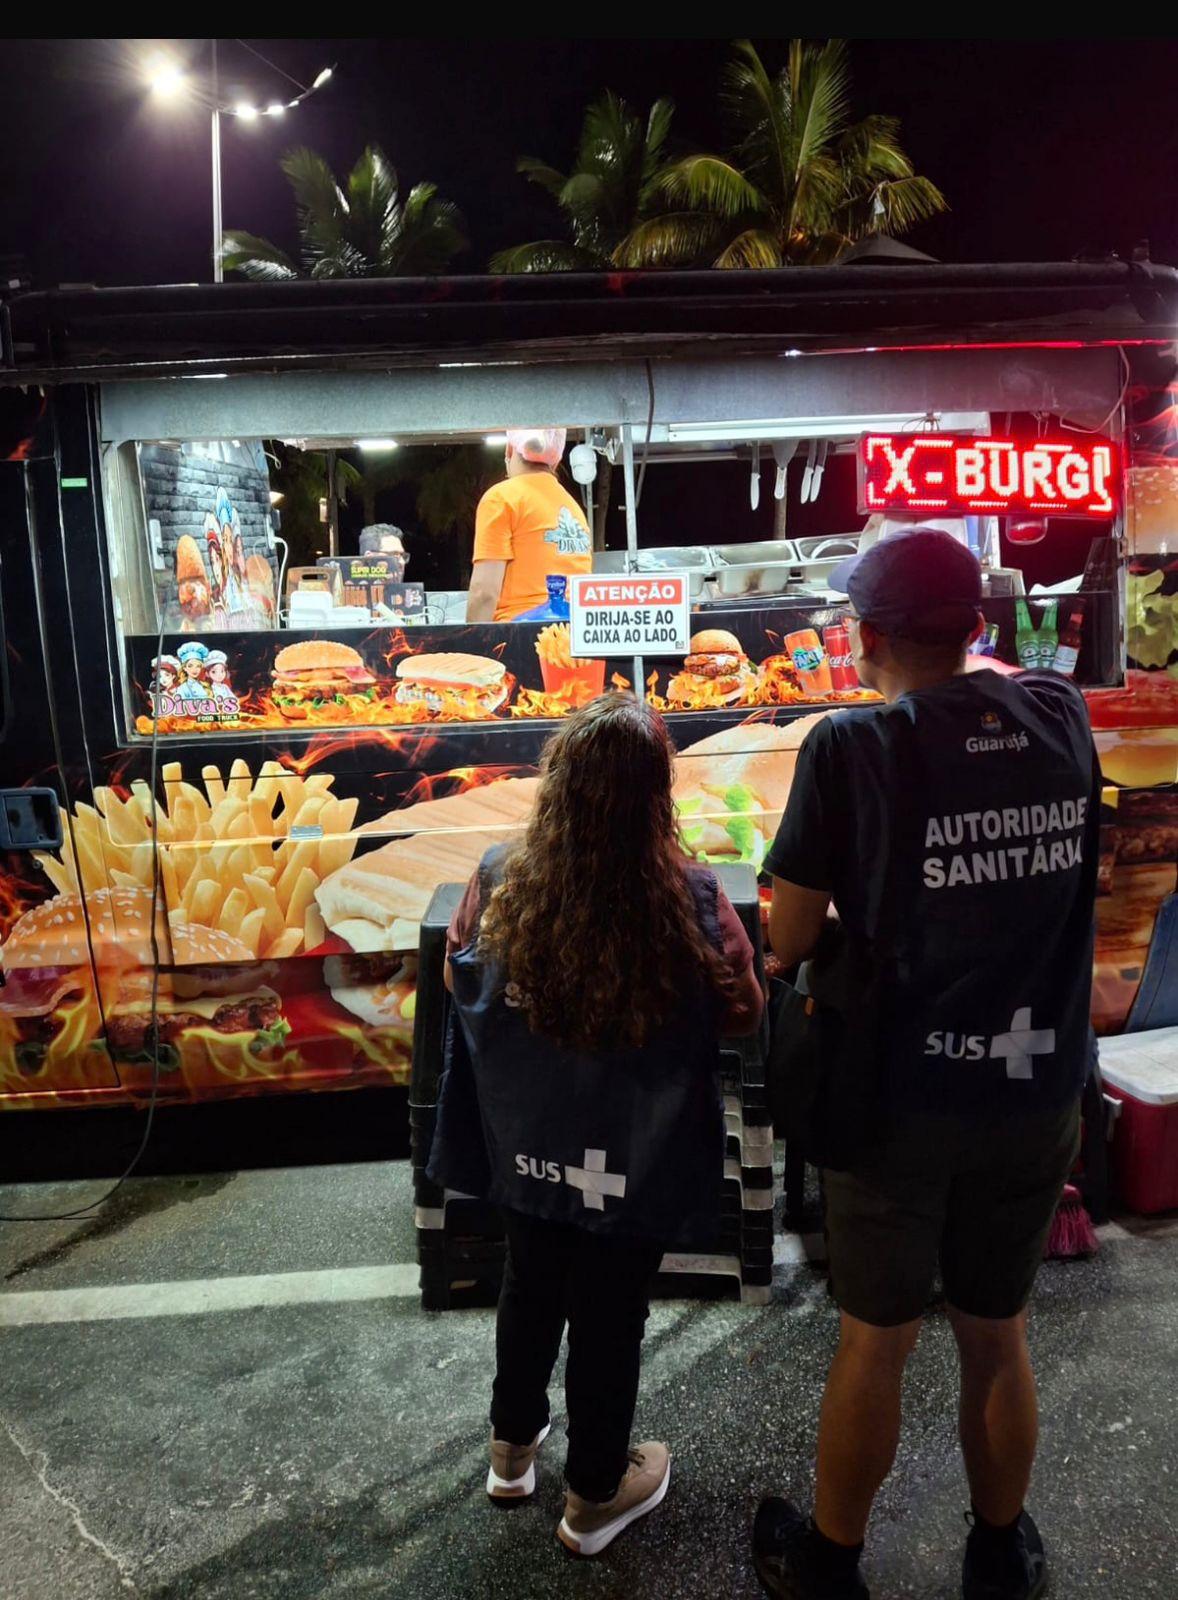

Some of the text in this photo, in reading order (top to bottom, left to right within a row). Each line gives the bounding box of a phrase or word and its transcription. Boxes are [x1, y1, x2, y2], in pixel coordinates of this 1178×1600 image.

[583, 582, 676, 603] ATENÇÃO
[585, 609, 674, 626] DIRIJA-SE AO
[583, 627, 677, 644] CAIXA AO LADO
[148, 692, 239, 717] Diva's
[966, 731, 1030, 752] Guarujá
[925, 797, 1087, 848] AUTORIDADE
[924, 1031, 986, 1060] SUS
[515, 1153, 561, 1183] SUS
